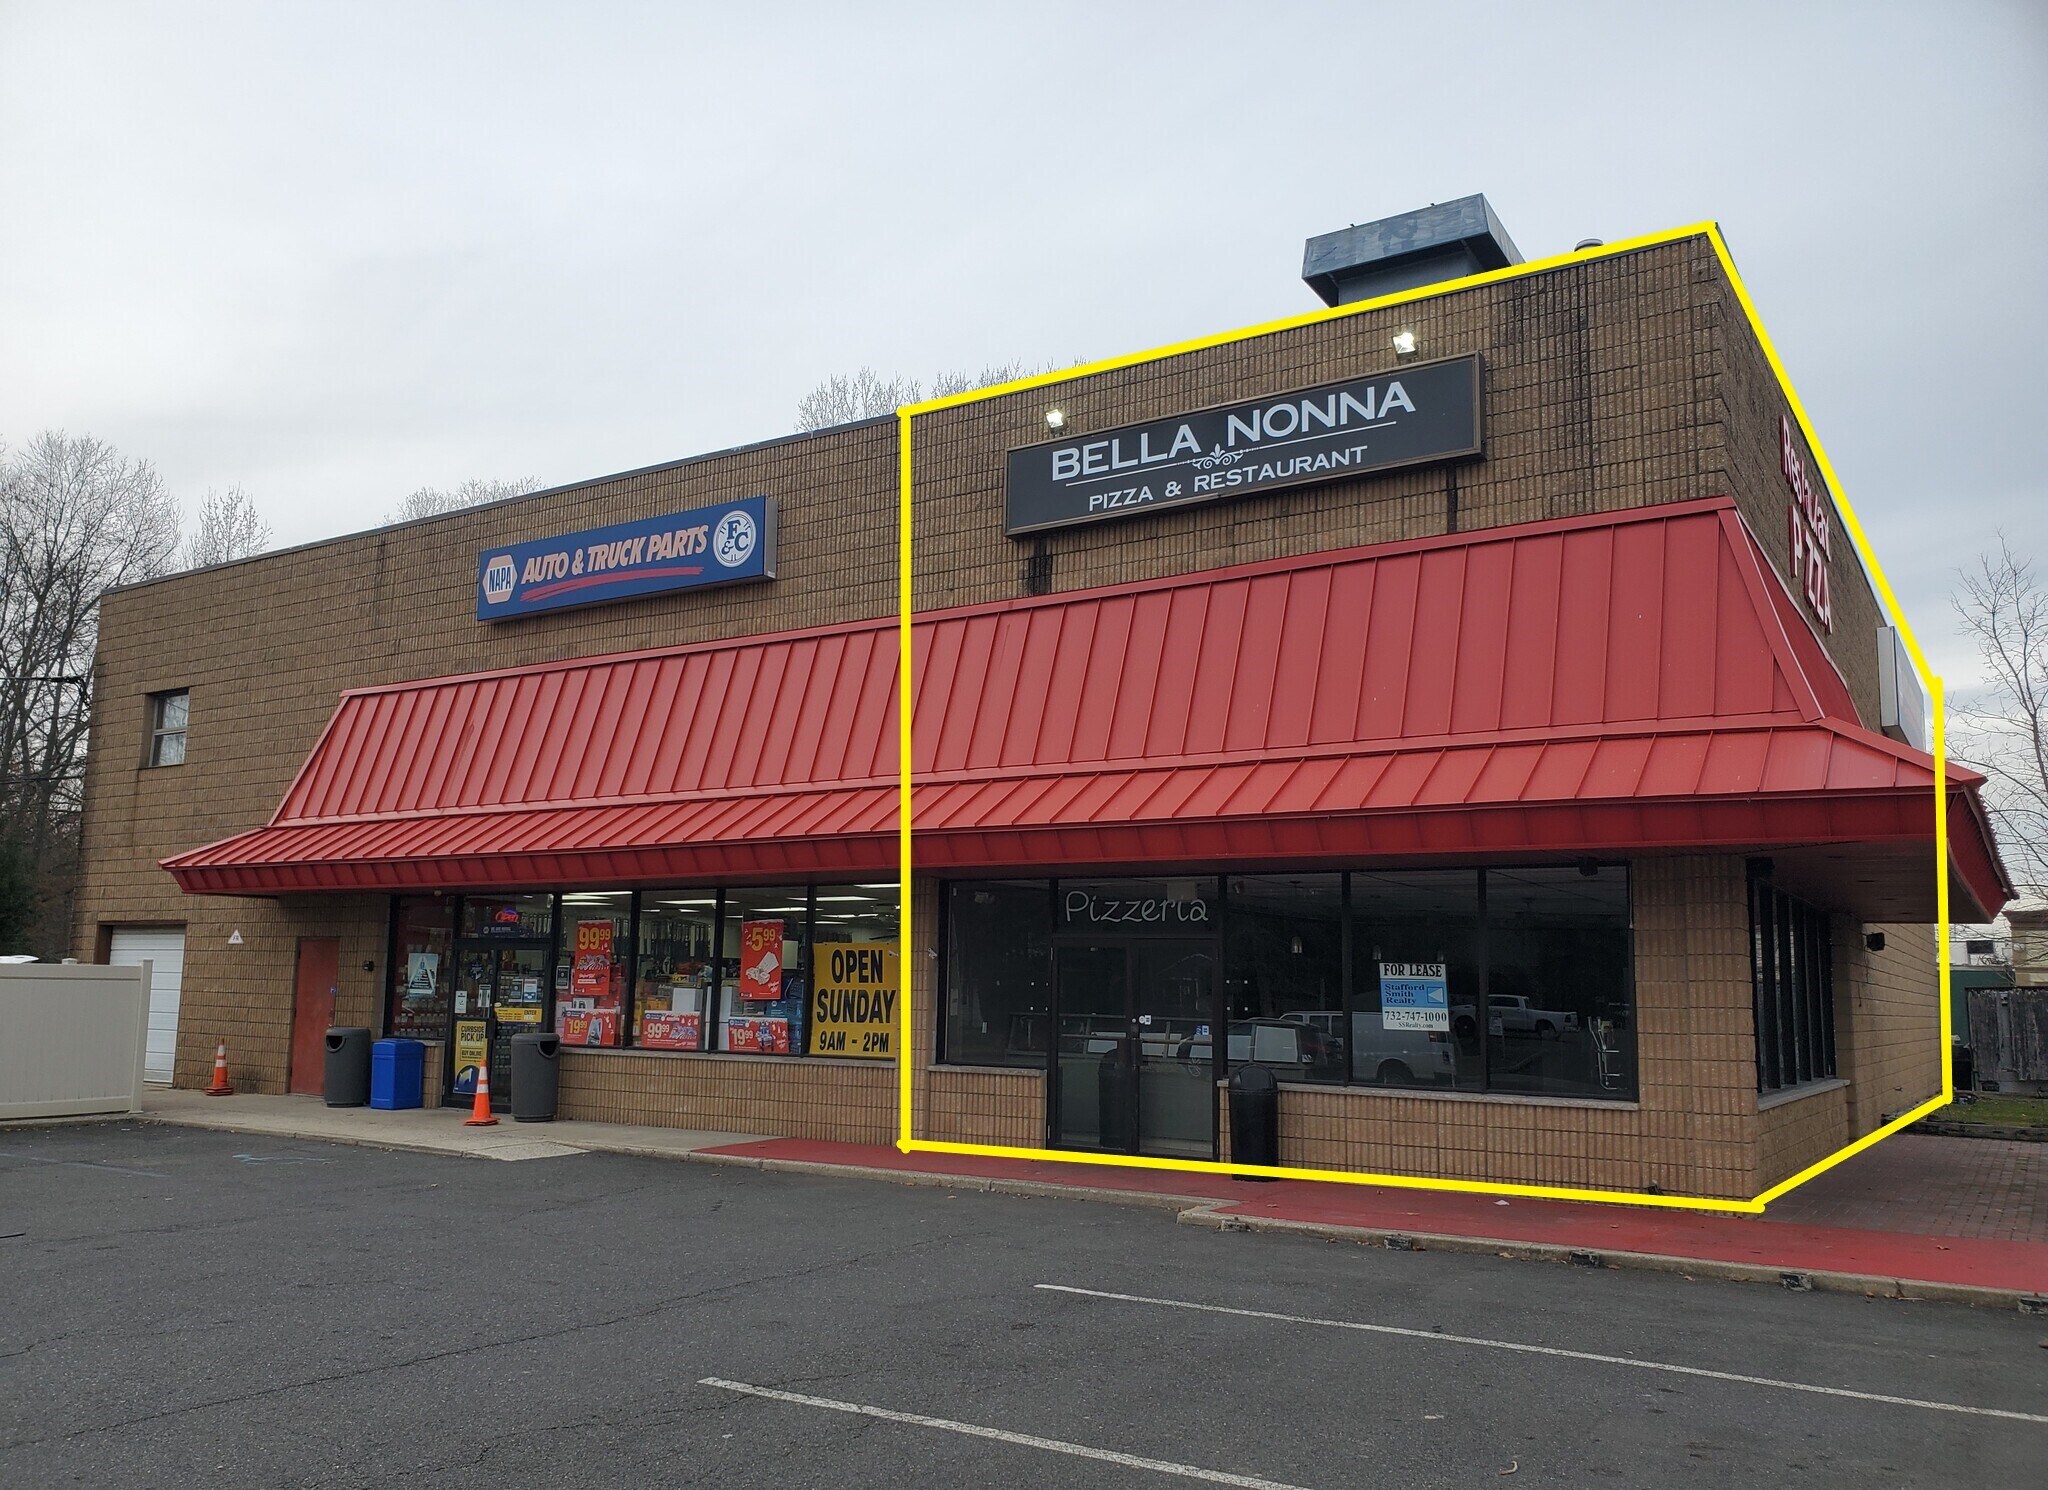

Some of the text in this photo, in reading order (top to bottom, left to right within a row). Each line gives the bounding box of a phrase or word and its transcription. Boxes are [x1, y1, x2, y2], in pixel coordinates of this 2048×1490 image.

[1051, 381, 1416, 482] BELLA NONNA
[1089, 445, 1368, 511] PIZZA & RESTAURANT
[521, 524, 709, 584] AUTO & TRUCK PARTS
[488, 566, 512, 593] NAPA
[1065, 889, 1209, 922] Pizzeria
[831, 949, 883, 984] OPEN
[1383, 963, 1442, 977] FOR LEASE
[816, 988, 896, 1023] SUNDAY
[1386, 997, 1417, 1005] Realty
[1384, 1011, 1447, 1022] 732-747-1000
[461, 1032, 475, 1041] PICK
[819, 1030, 846, 1051] 9AM
[862, 1032, 889, 1052] 2PM
